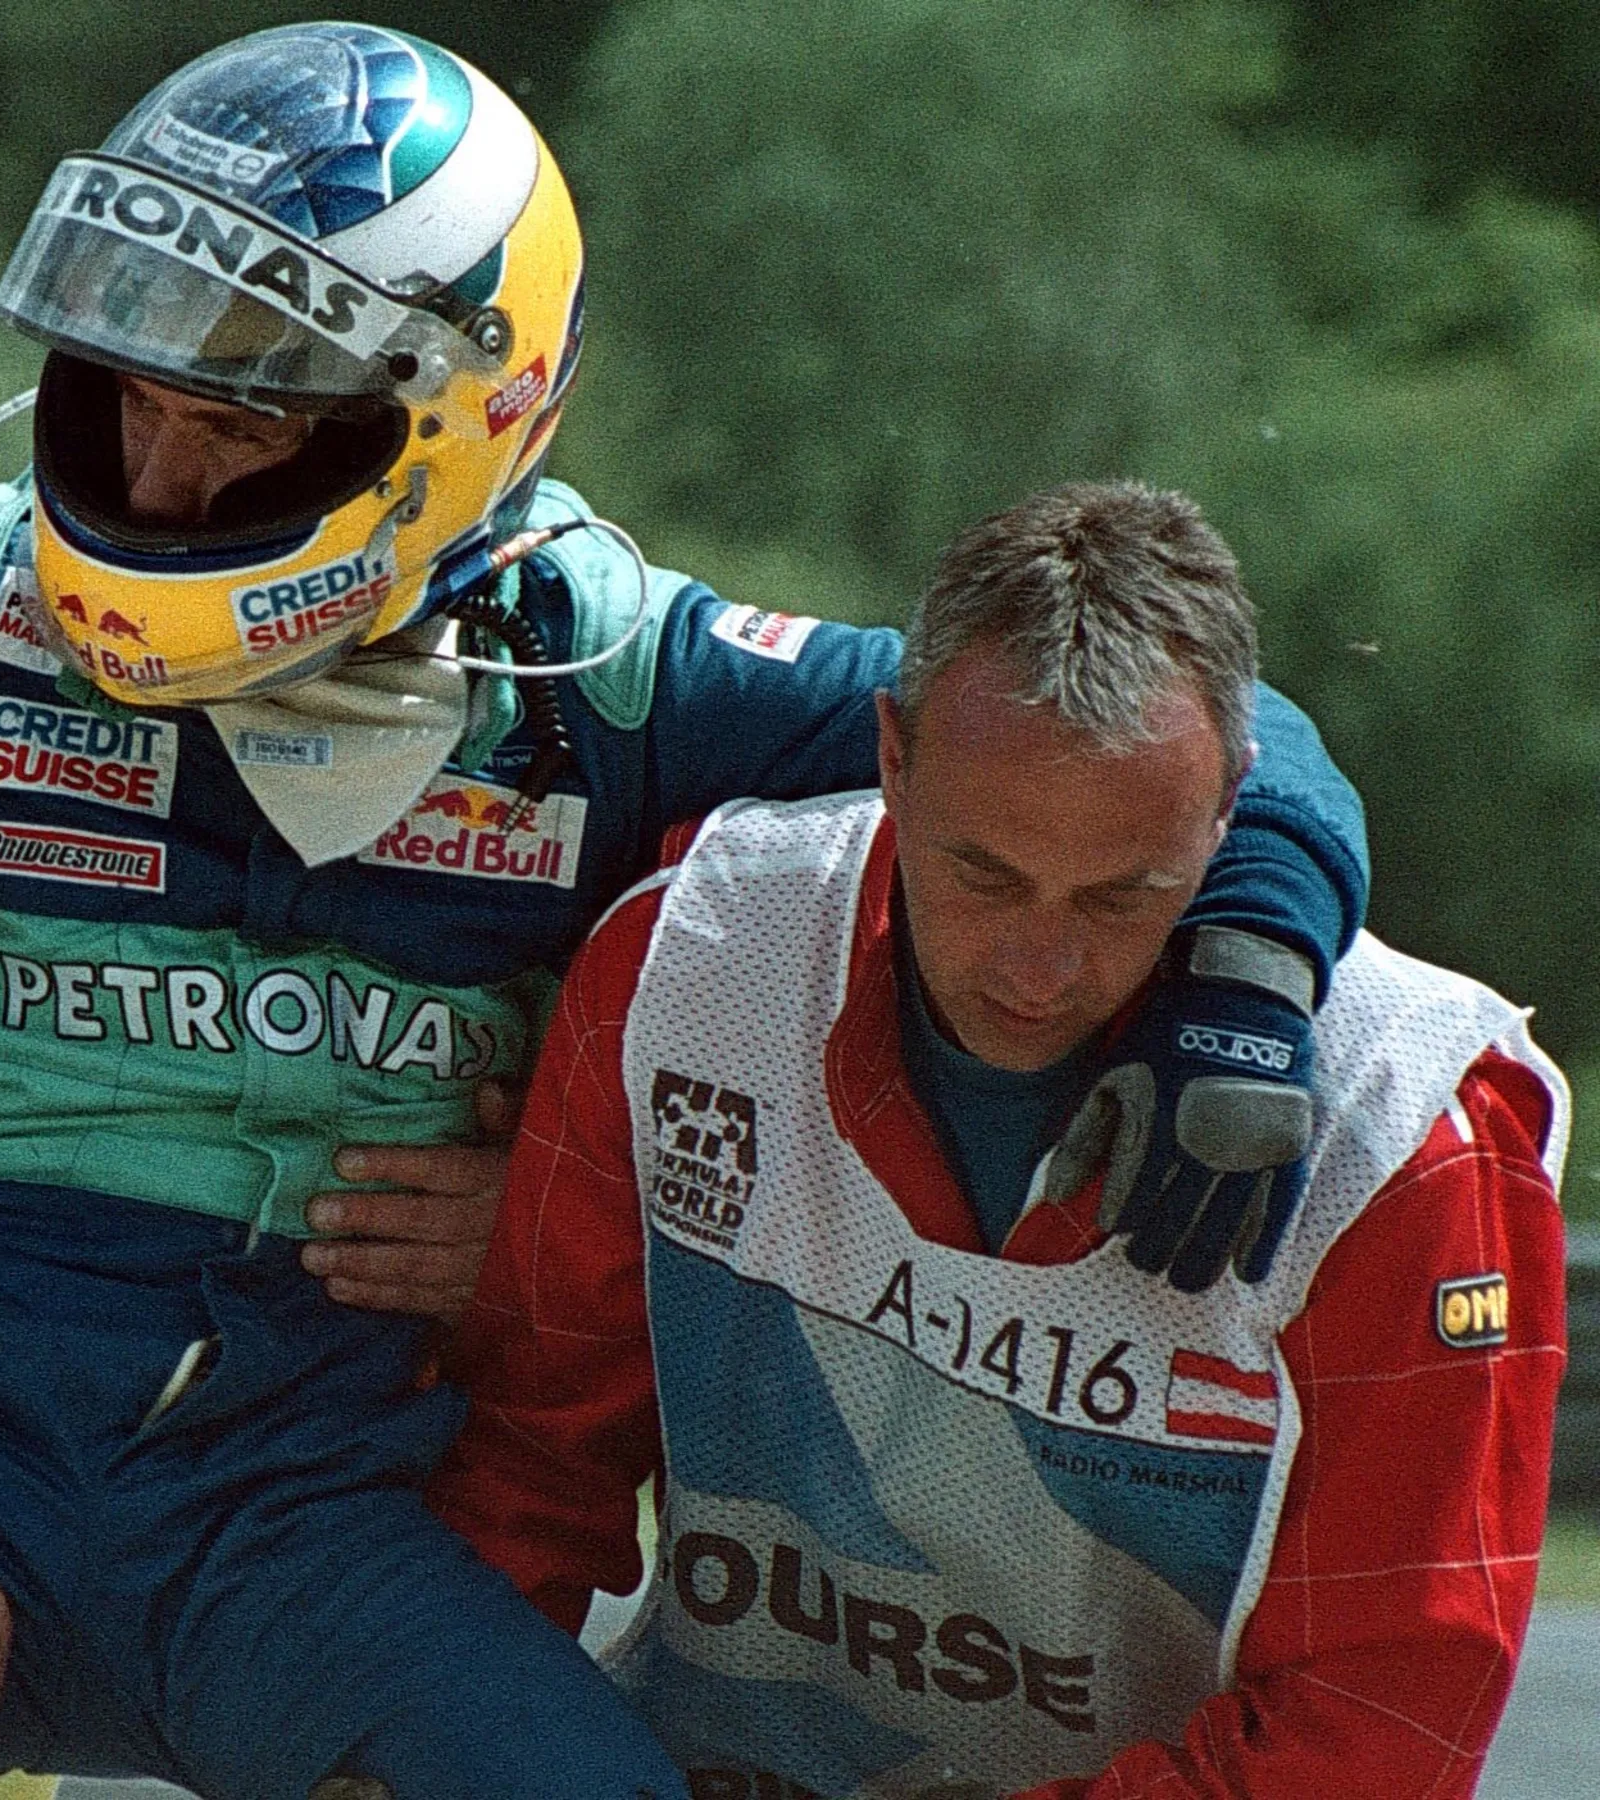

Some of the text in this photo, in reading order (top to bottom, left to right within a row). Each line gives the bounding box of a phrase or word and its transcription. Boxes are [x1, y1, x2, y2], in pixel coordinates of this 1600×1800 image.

[488, 369, 534, 414] auto
[100, 649, 170, 687] Bull
[375, 818, 564, 880] Red Bull
[1179, 1028, 1293, 1071] sparco
[1040, 1445, 1248, 1496] RADIO MARSHAL
